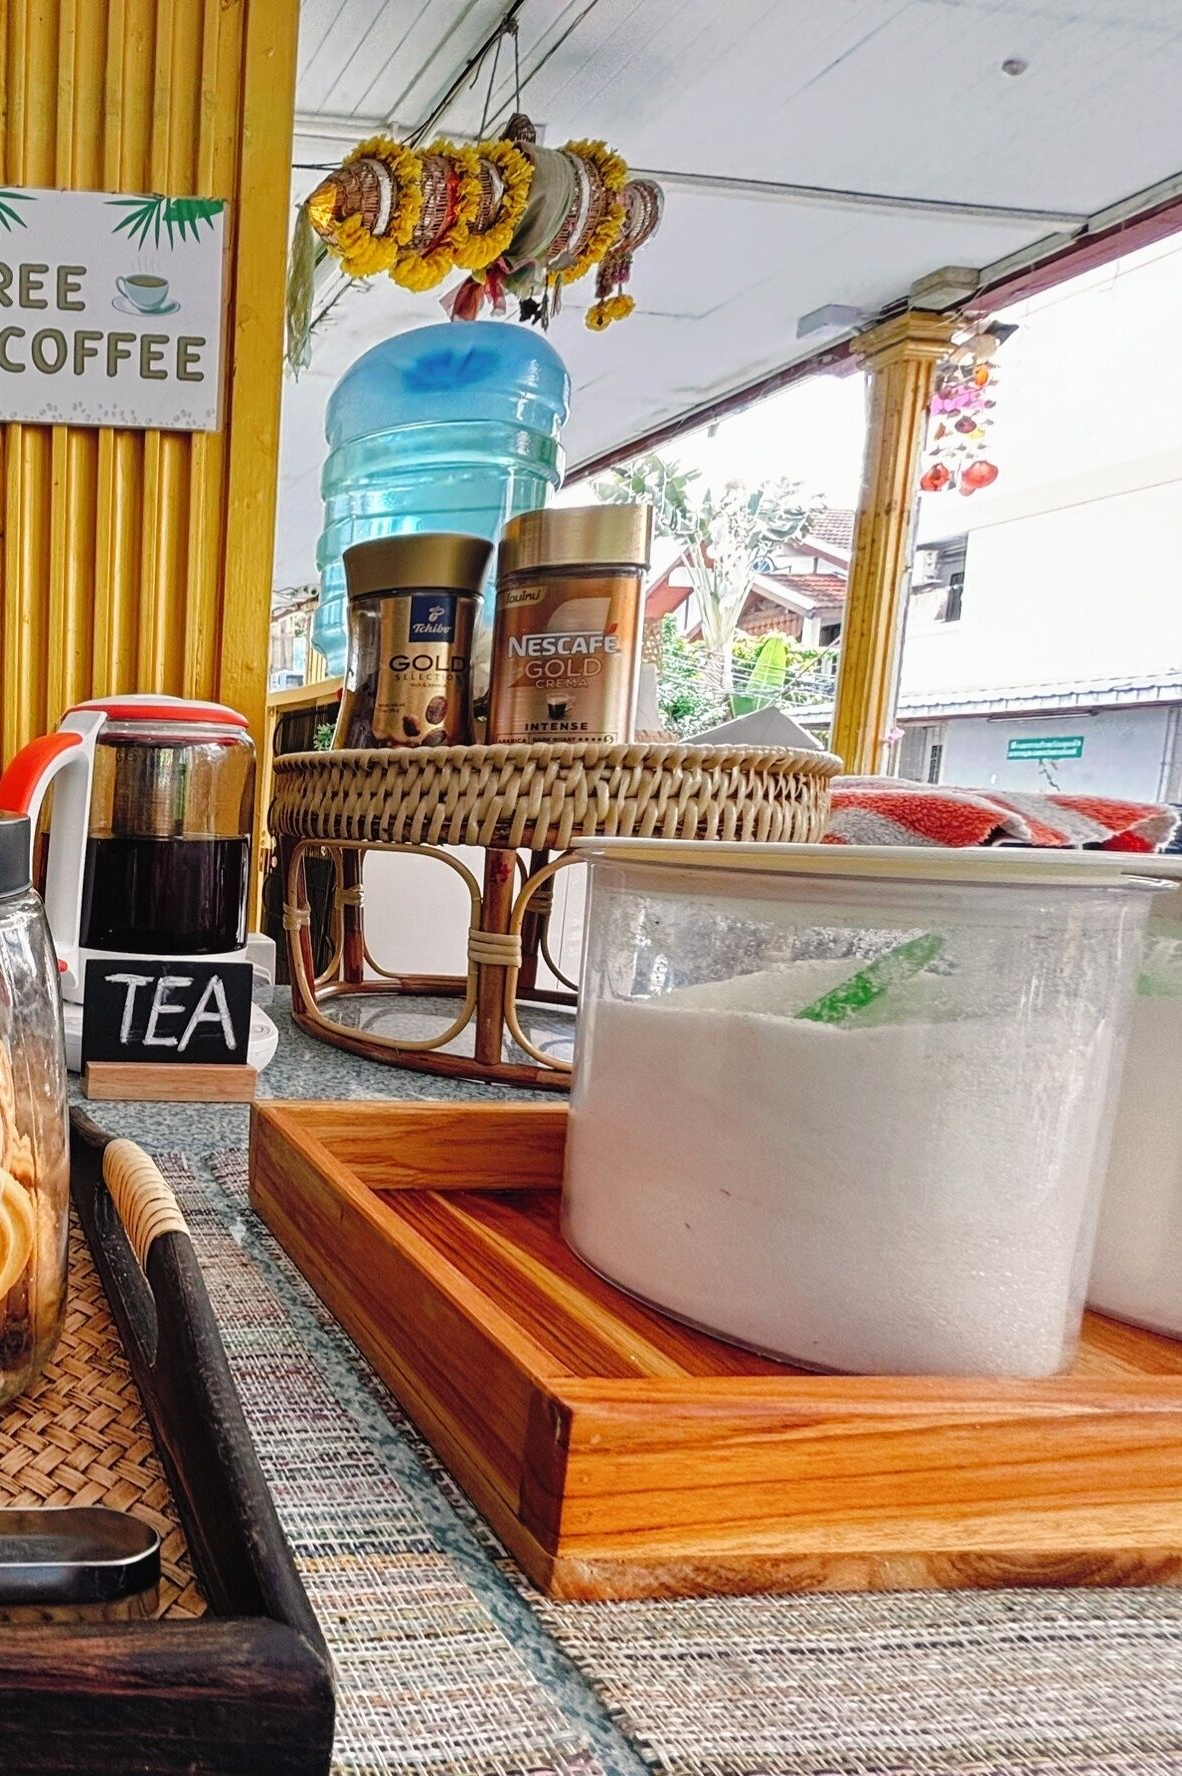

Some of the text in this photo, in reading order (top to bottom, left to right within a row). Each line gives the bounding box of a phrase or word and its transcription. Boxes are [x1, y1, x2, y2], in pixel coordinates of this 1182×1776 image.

[412, 623, 452, 634] Tchibo
[389, 654, 467, 673] GOLD
[525, 657, 603, 679] GOLD
[535, 678, 590, 690] CREMA
[524, 722, 589, 732] INTENSE
[104, 973, 237, 1052] TEA
